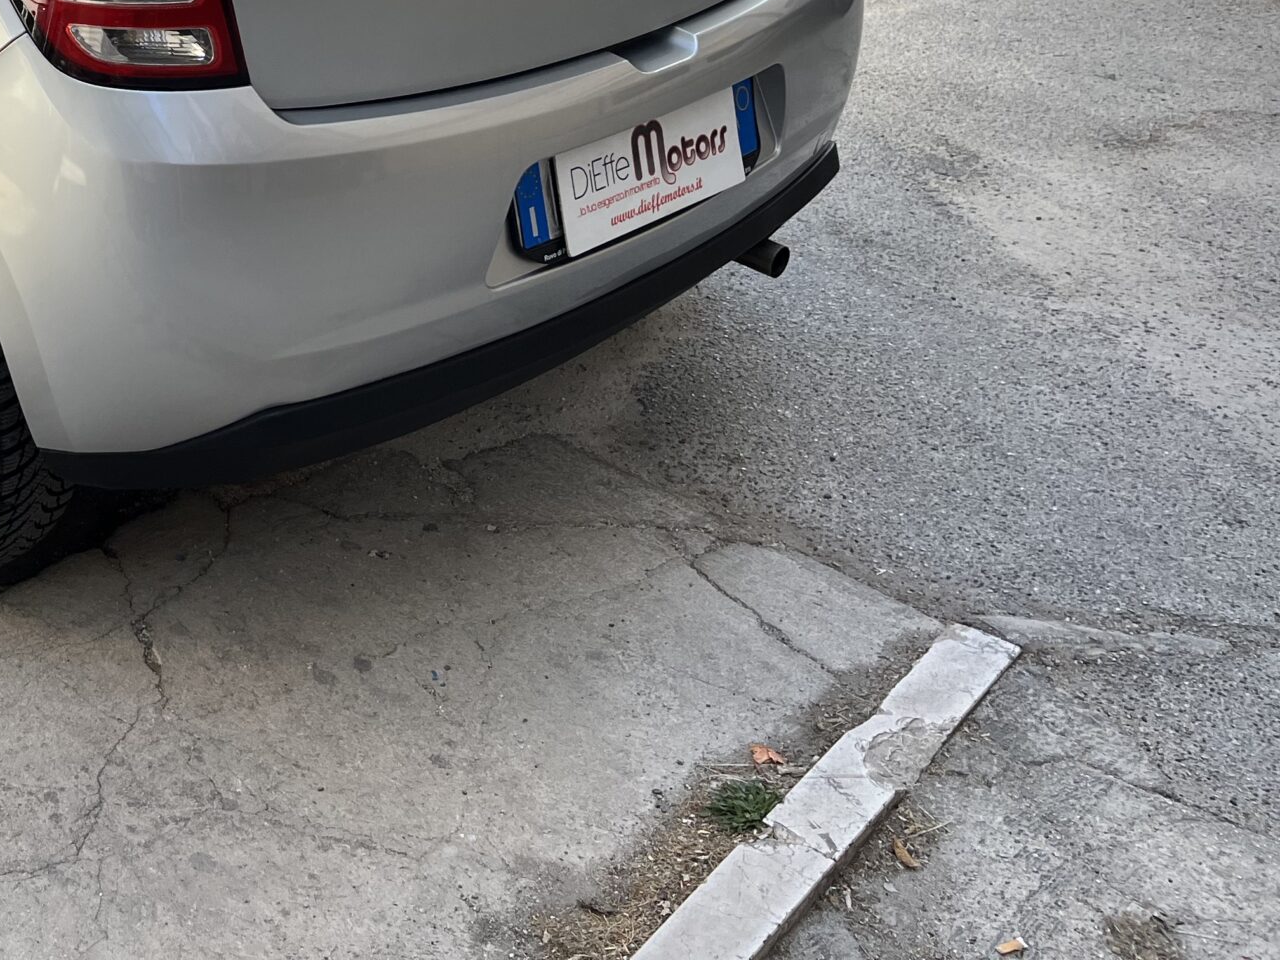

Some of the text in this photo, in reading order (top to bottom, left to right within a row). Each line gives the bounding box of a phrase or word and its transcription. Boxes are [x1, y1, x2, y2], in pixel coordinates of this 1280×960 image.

[570, 119, 728, 200] DiEffe Motors
[610, 177, 703, 226] www.dieffemotors.it
